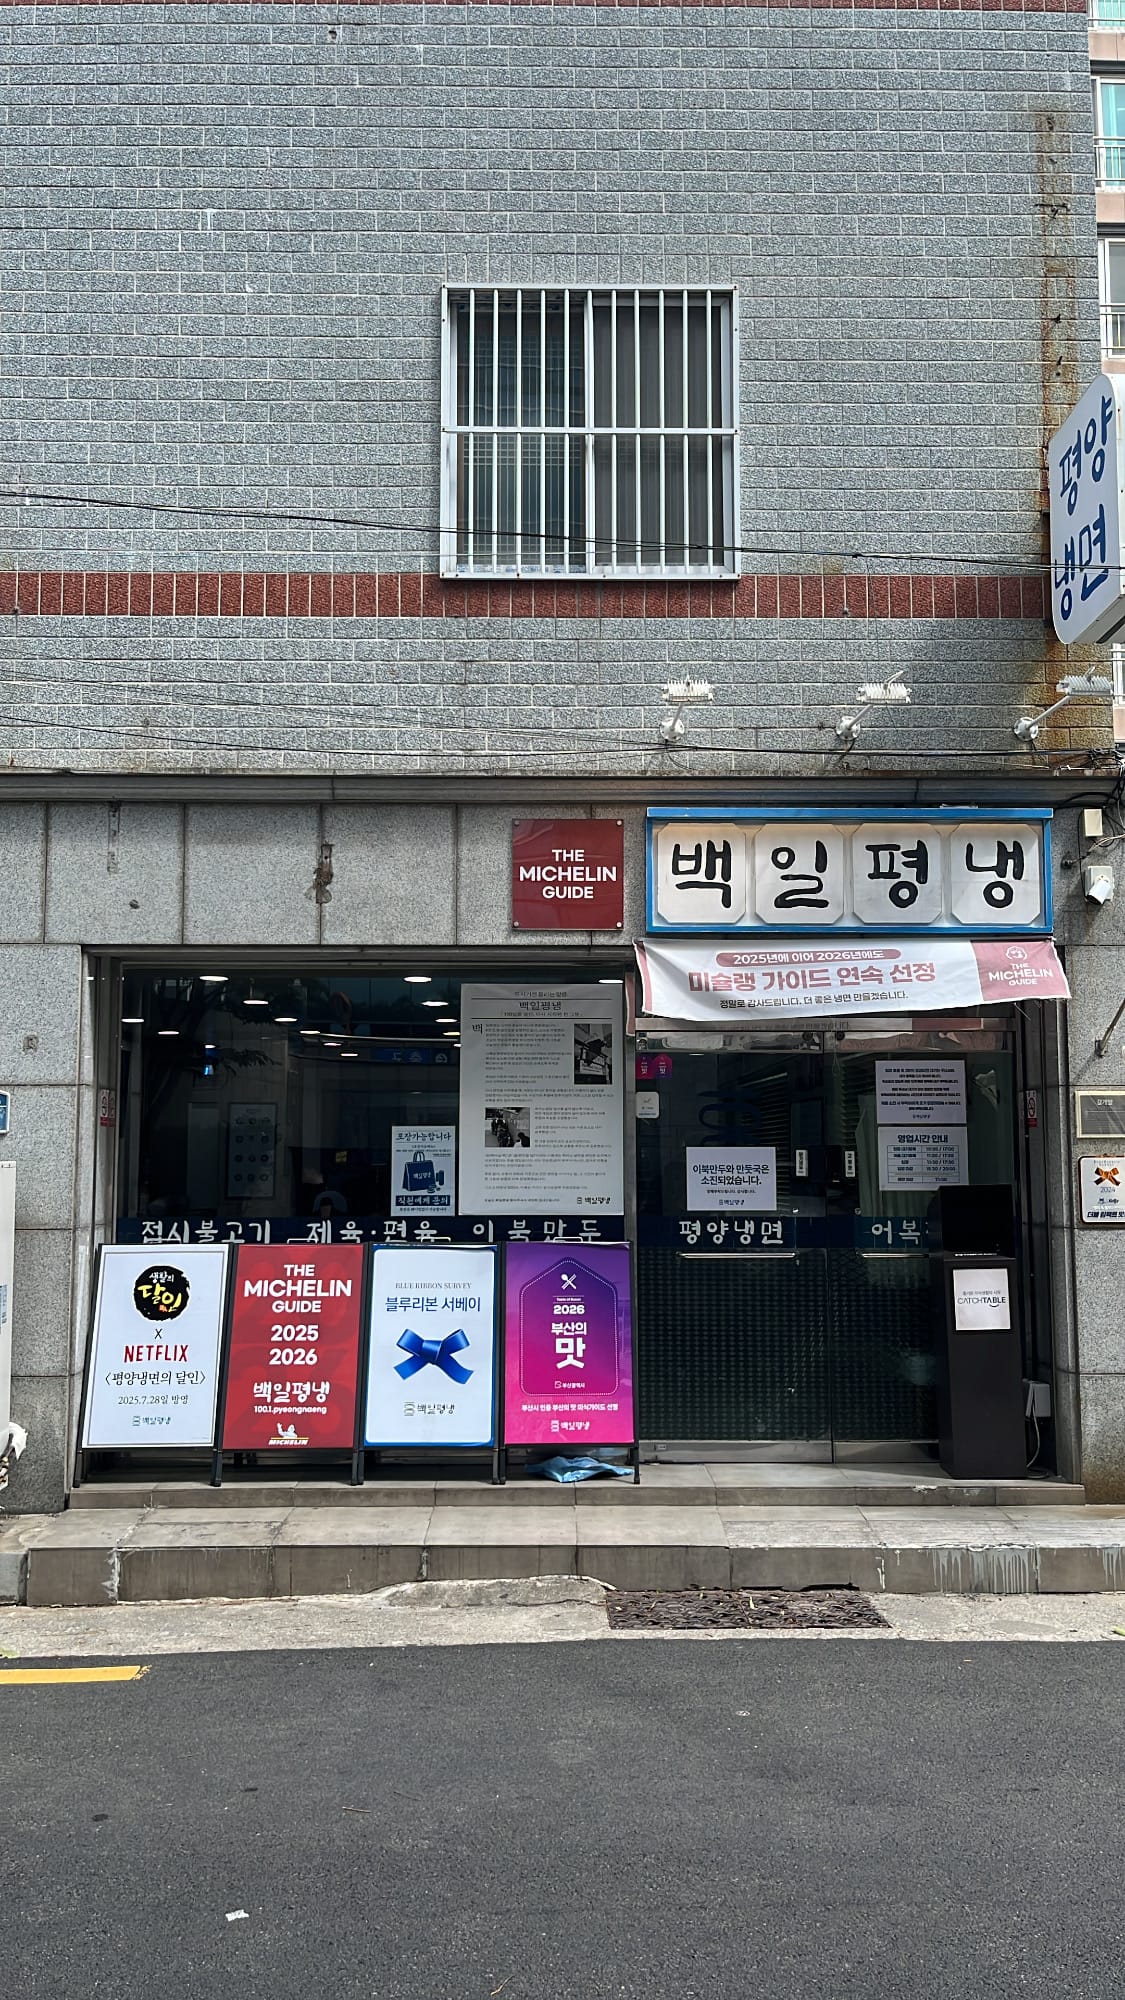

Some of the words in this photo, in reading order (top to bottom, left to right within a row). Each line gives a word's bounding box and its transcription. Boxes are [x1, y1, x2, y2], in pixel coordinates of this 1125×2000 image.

[1060, 396, 1113, 516] 평양
[1055, 504, 1109, 621] 냉면
[552, 849, 585, 862] THE
[519, 866, 617, 882] MICHELIN
[671, 839, 1025, 909] 백일평냉
[542, 885, 594, 899] GUIDE
[734, 953, 790, 965] 2025년에
[791, 951, 815, 962] 이어
[817, 950, 885, 961] 2026년에도
[688, 971, 756, 992] 미슐랭
[763, 968, 832, 991] 가이드
[836, 965, 884, 986] 연속
[889, 963, 936, 983] 선정
[988, 968, 1054, 982] MICHELIN
[1008, 978, 1038, 986] GUIDE
[519, 1001, 562, 1011] 백일평냉
[720, 999, 746, 1009] 정말로
[747, 997, 802, 1008] 감사드립니다.
[803, 996, 813, 1005] 더
[815, 995, 833, 1004] 좋은
[834, 993, 852, 1003] 냉면
[853, 990, 909, 1002] 만들겠습니다.
[396, 1131, 452, 1141] 포장가능합니다
[897, 1134, 931, 1144] 영업시간
[932, 1134, 949, 1144] 안내
[692, 1164, 735, 1175] 이북만두와
[700, 1175, 762, 1186] 소진되었습니다.
[141, 1219, 271, 1244] 접시불고기
[678, 1219, 784, 1245] 평양냉면
[871, 1219, 929, 1245] 어복
[149, 1271, 174, 1283] 생활의
[284, 1264, 315, 1276] THE
[244, 1279, 352, 1297] MICHELIN
[137, 1282, 182, 1312] 달인
[385, 1296, 438, 1312] 블루리본
[441, 1296, 481, 1312] 서베이
[957, 1296, 1006, 1305] CATCHTABLE
[272, 1300, 322, 1313] GUIDE
[553, 1304, 585, 1315] 2026
[270, 1324, 319, 1341] 2025
[551, 1321, 587, 1336] 부산의
[124, 1344, 189, 1363] NETFLIX
[269, 1348, 318, 1365] 2026
[555, 1337, 586, 1369] 맛
[253, 1381, 330, 1403] 백일평냉
[118, 1394, 169, 1405] 2025.7.28일
[171, 1394, 189, 1405] 방영
[254, 1405, 327, 1415] 100.1.pyeongnaeng
[417, 1403, 455, 1415] 백일평냉
